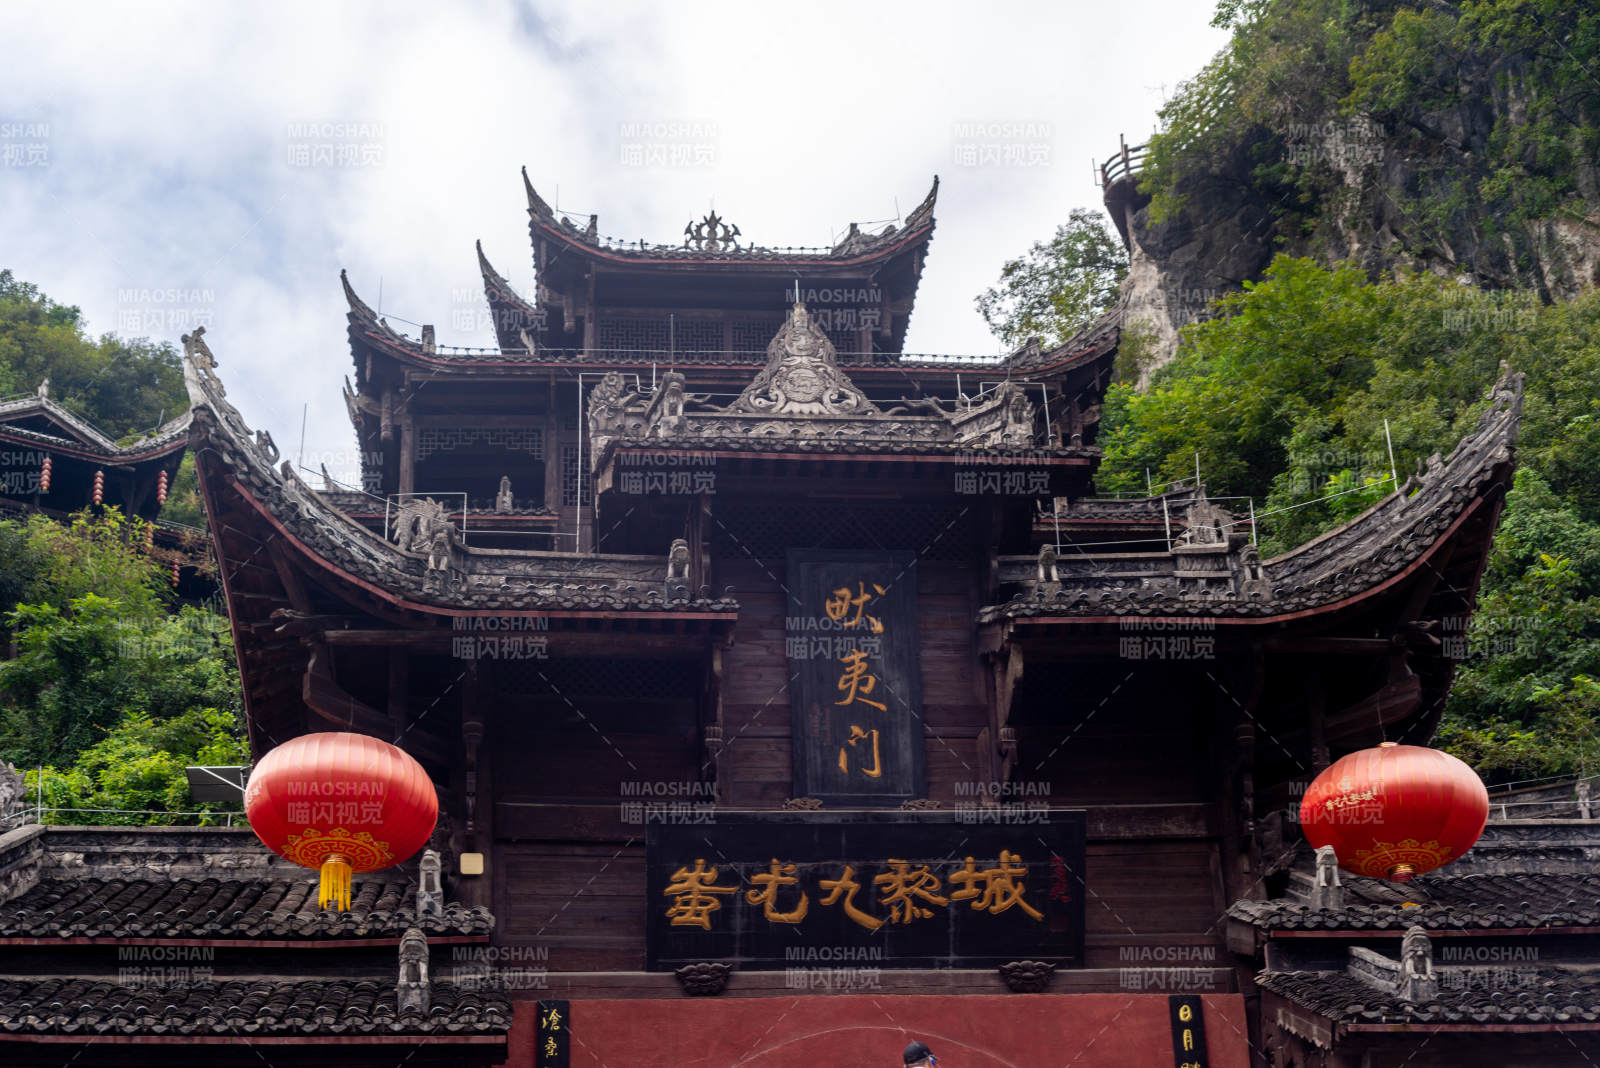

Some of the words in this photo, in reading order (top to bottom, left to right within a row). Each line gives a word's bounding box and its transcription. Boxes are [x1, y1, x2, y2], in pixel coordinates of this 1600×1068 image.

[663, 849, 1045, 931] 蚩尤九黎城
